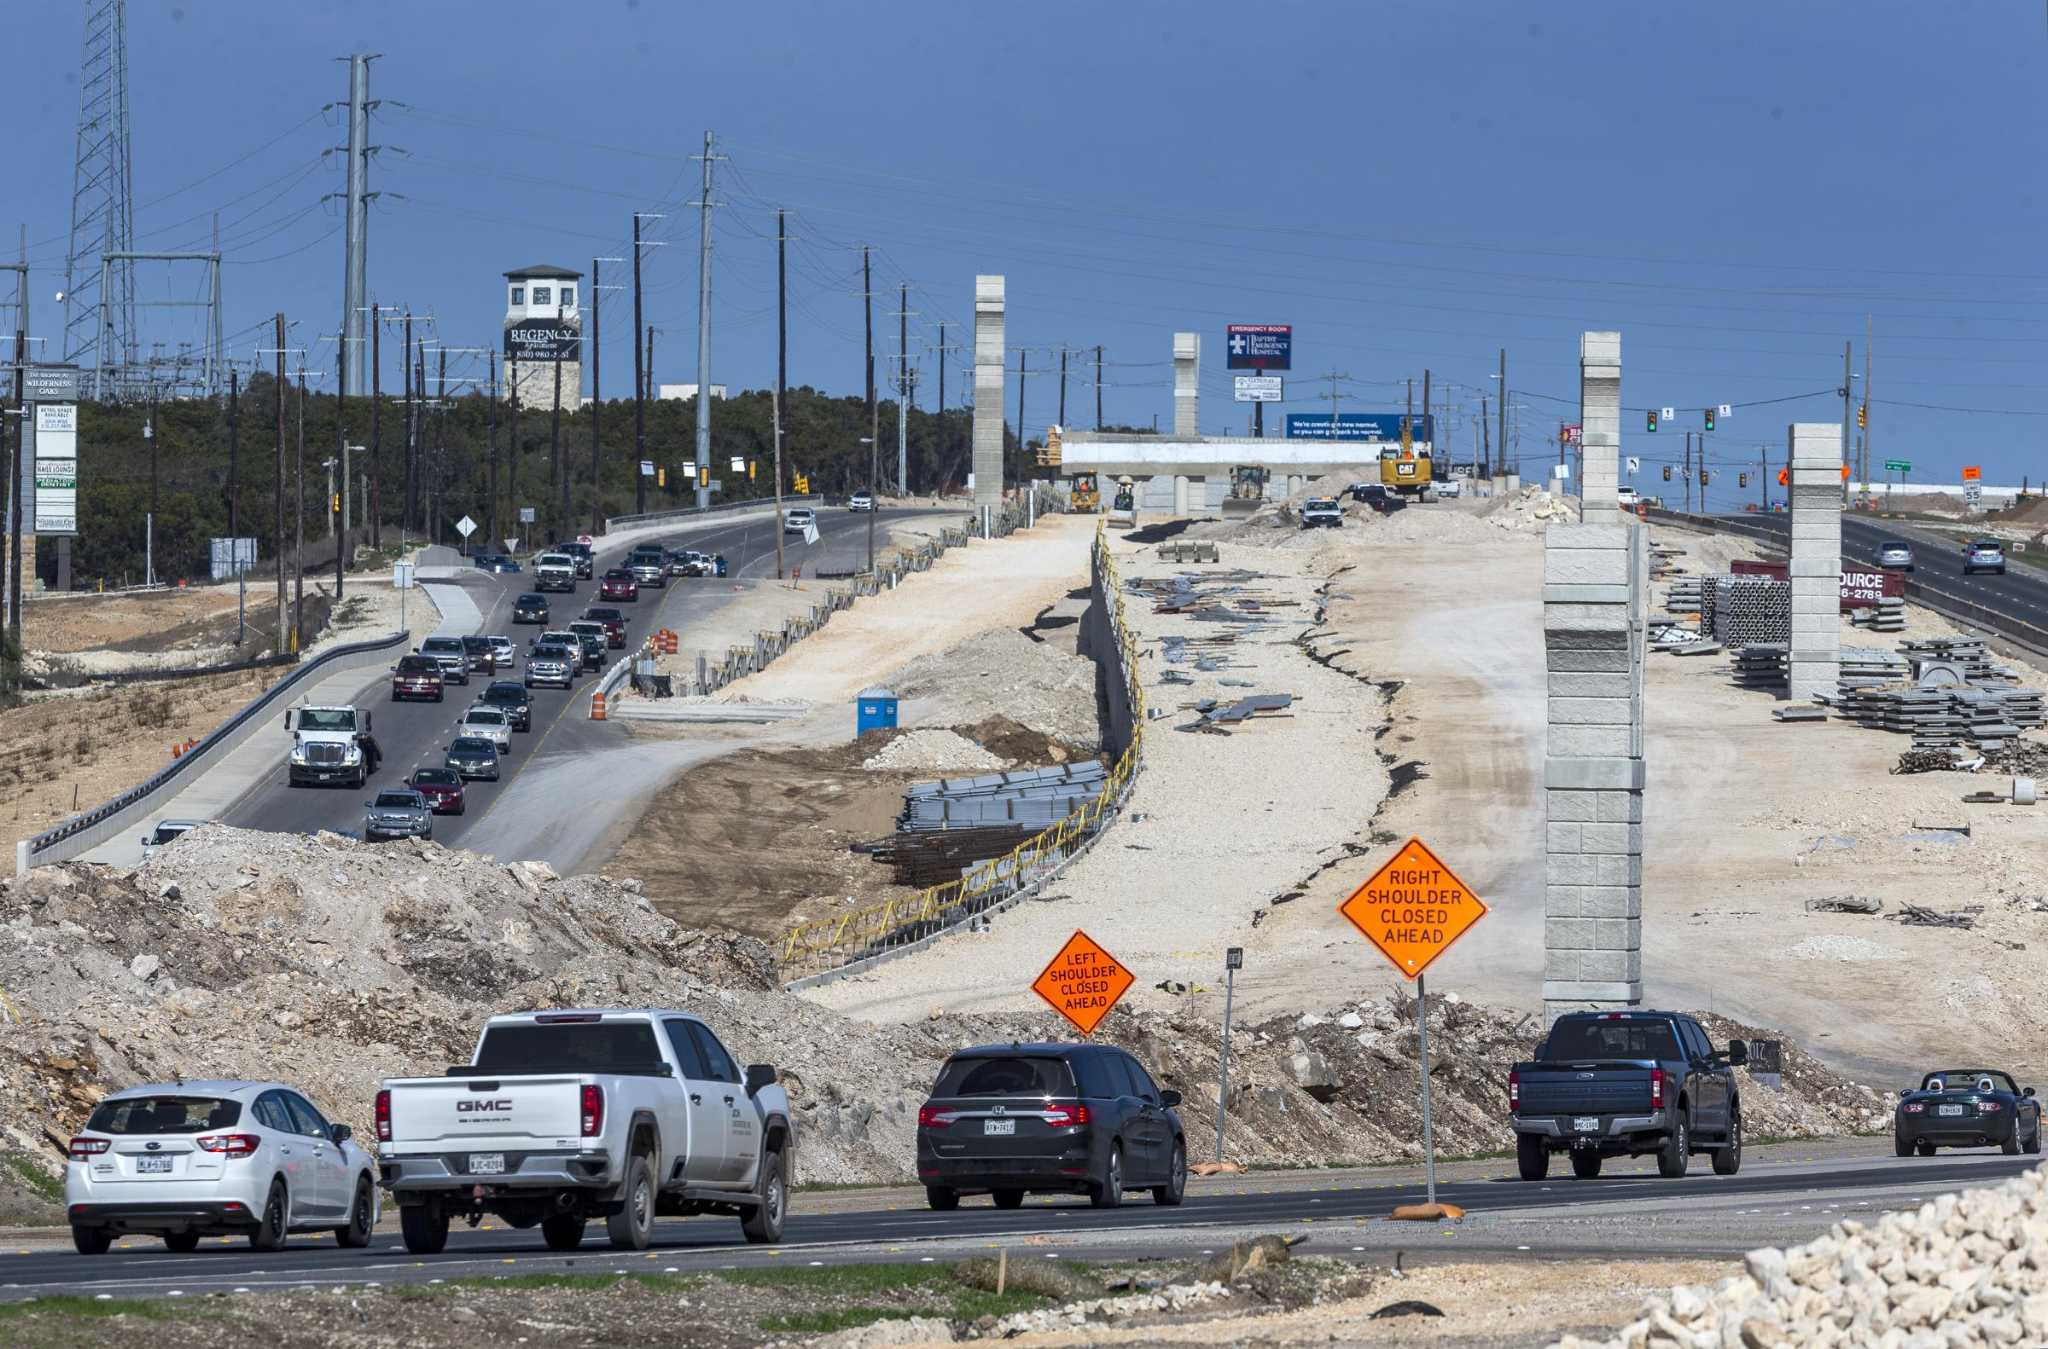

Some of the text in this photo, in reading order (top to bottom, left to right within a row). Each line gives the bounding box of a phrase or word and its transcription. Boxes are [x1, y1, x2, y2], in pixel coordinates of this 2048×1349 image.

[511, 329, 573, 341] REGENCY
[1398, 464, 1414, 474] CAT
[1966, 491, 1980, 499] 55
[1390, 870, 1441, 885] RIGHT
[1367, 890, 1462, 904] SHOULDER
[1381, 909, 1448, 924] CLOSED
[1384, 929, 1444, 943] AHEAD
[1067, 952, 1097, 966] LEFT
[1050, 965, 1117, 982] SHOULDER
[1061, 980, 1109, 995] CLOSED
[1065, 996, 1107, 1009] AHEAD
[457, 1100, 512, 1112] GMC
